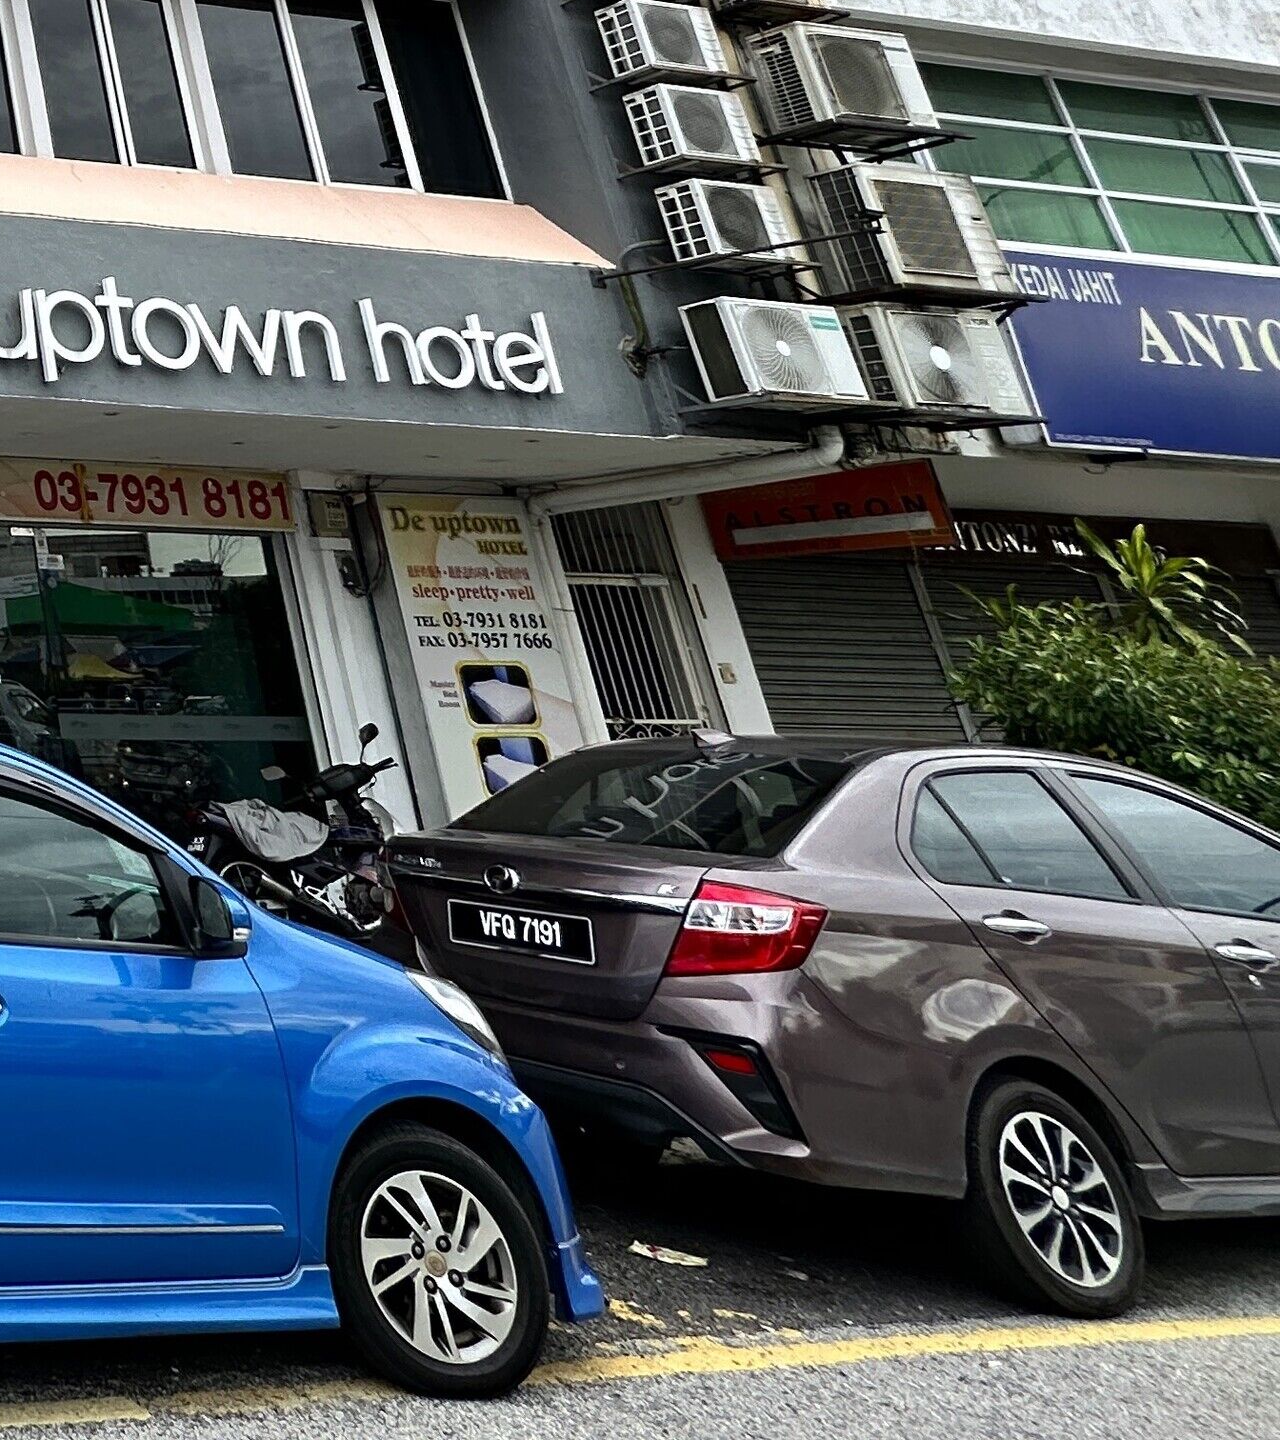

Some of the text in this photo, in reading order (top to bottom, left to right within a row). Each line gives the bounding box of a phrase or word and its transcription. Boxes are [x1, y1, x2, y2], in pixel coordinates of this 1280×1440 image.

[1007, 263, 1122, 305] KEDAI JAHIT
[356, 296, 564, 395] hotel
[34, 469, 188, 516] 03-7931
[201, 477, 290, 521] 8181
[390, 507, 522, 540] De uptown
[476, 539, 529, 555] HOTEL
[412, 583, 536, 602] sleep pretty well
[442, 612, 506, 628] 03-7931
[509, 613, 548, 629] 8181
[447, 632, 509, 648] 03-7957
[513, 633, 553, 650] 7666
[478, 910, 562, 949] VFQ 7191
